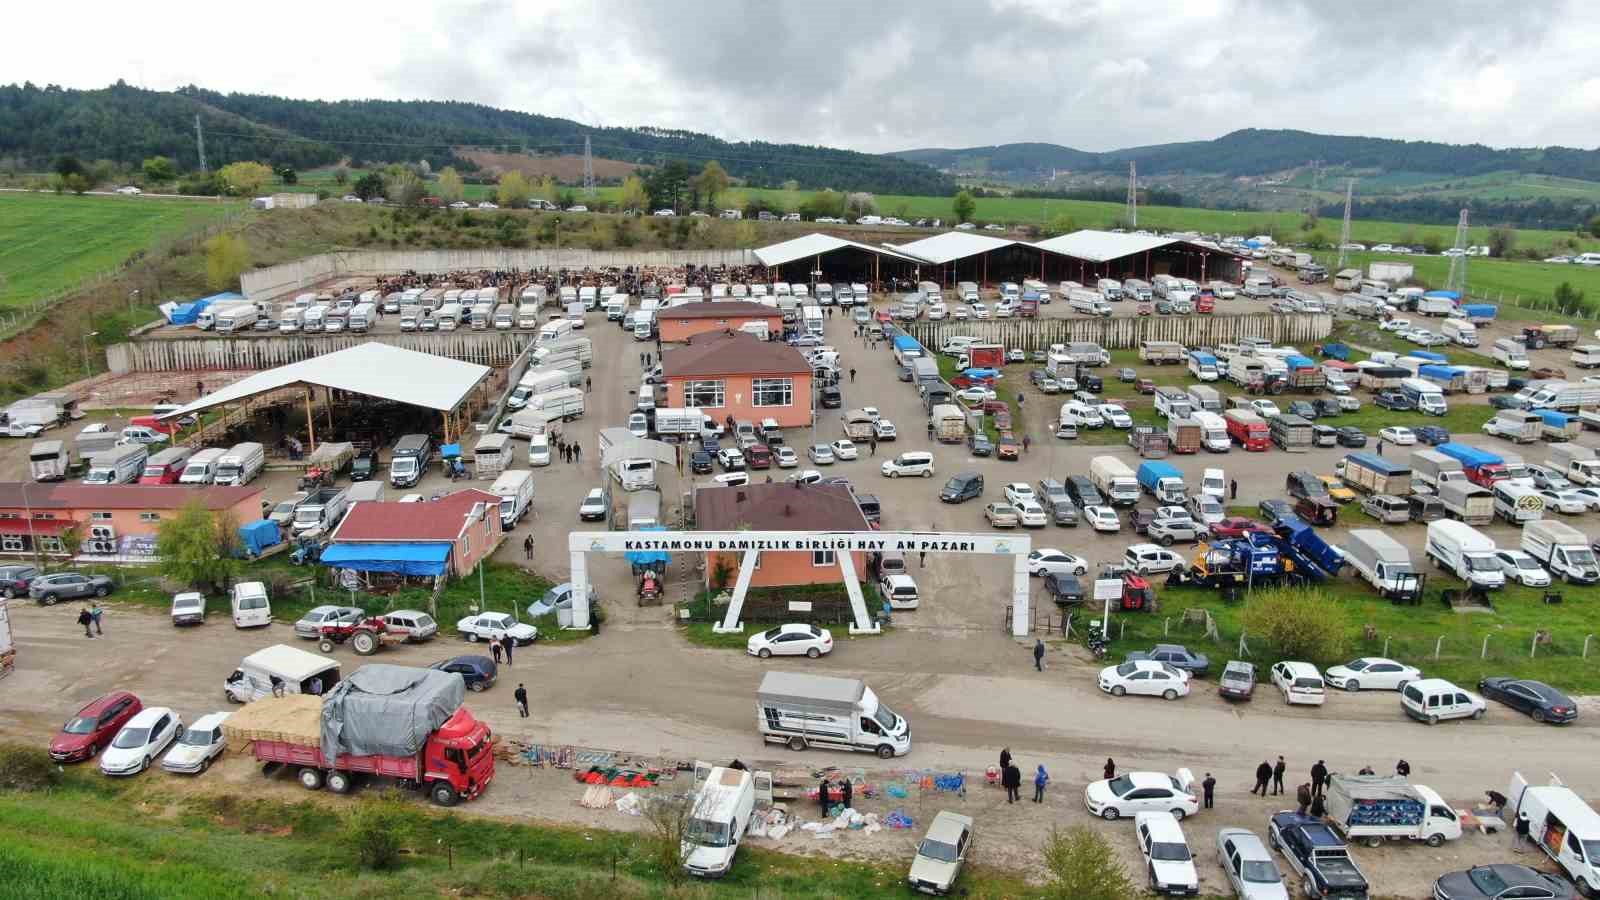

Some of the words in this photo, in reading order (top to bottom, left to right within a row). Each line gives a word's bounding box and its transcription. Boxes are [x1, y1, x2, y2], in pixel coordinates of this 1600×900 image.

[625, 540, 713, 550] KASTAMONU
[719, 540, 790, 550] DAMIZLIK
[795, 538, 852, 550] BİRLİĞİ
[921, 541, 976, 551] PAZARI
